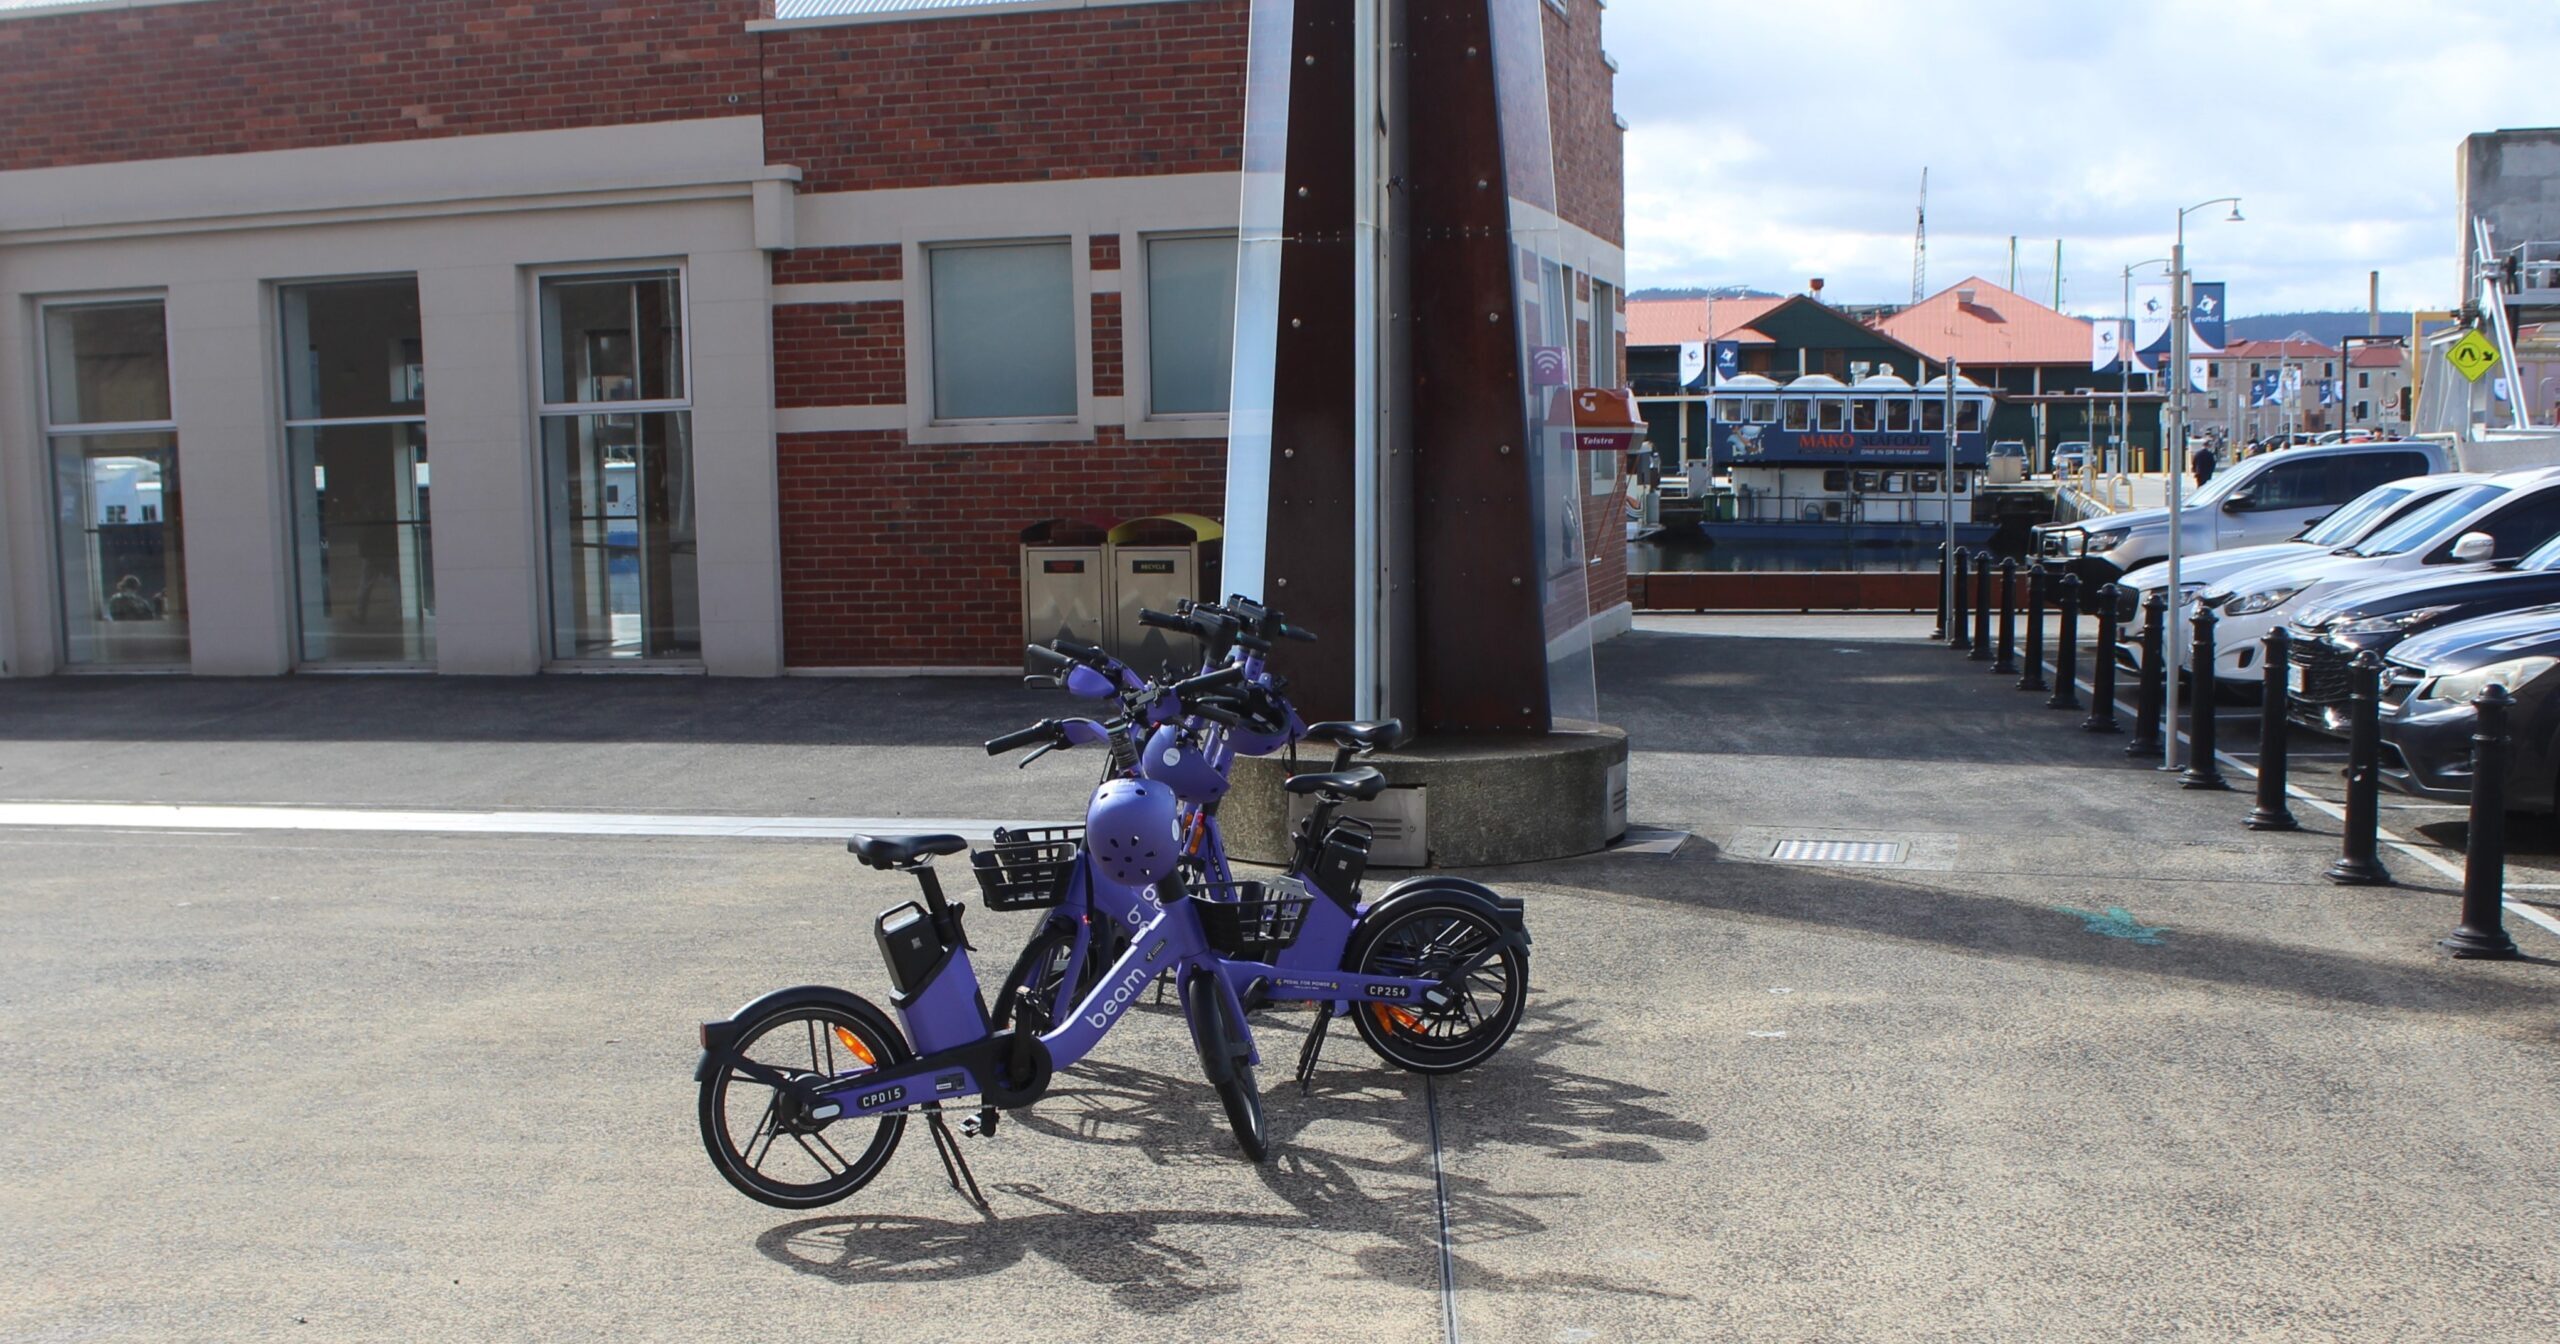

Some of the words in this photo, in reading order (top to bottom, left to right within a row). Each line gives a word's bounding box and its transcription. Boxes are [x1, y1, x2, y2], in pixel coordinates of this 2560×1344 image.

[1583, 436, 1614, 445] Telstra
[1799, 434, 1854, 448] MAKO
[1861, 435, 1930, 446] SEAFOOD
[1369, 986, 1406, 997] CP254
[1085, 968, 1147, 1029] beam
